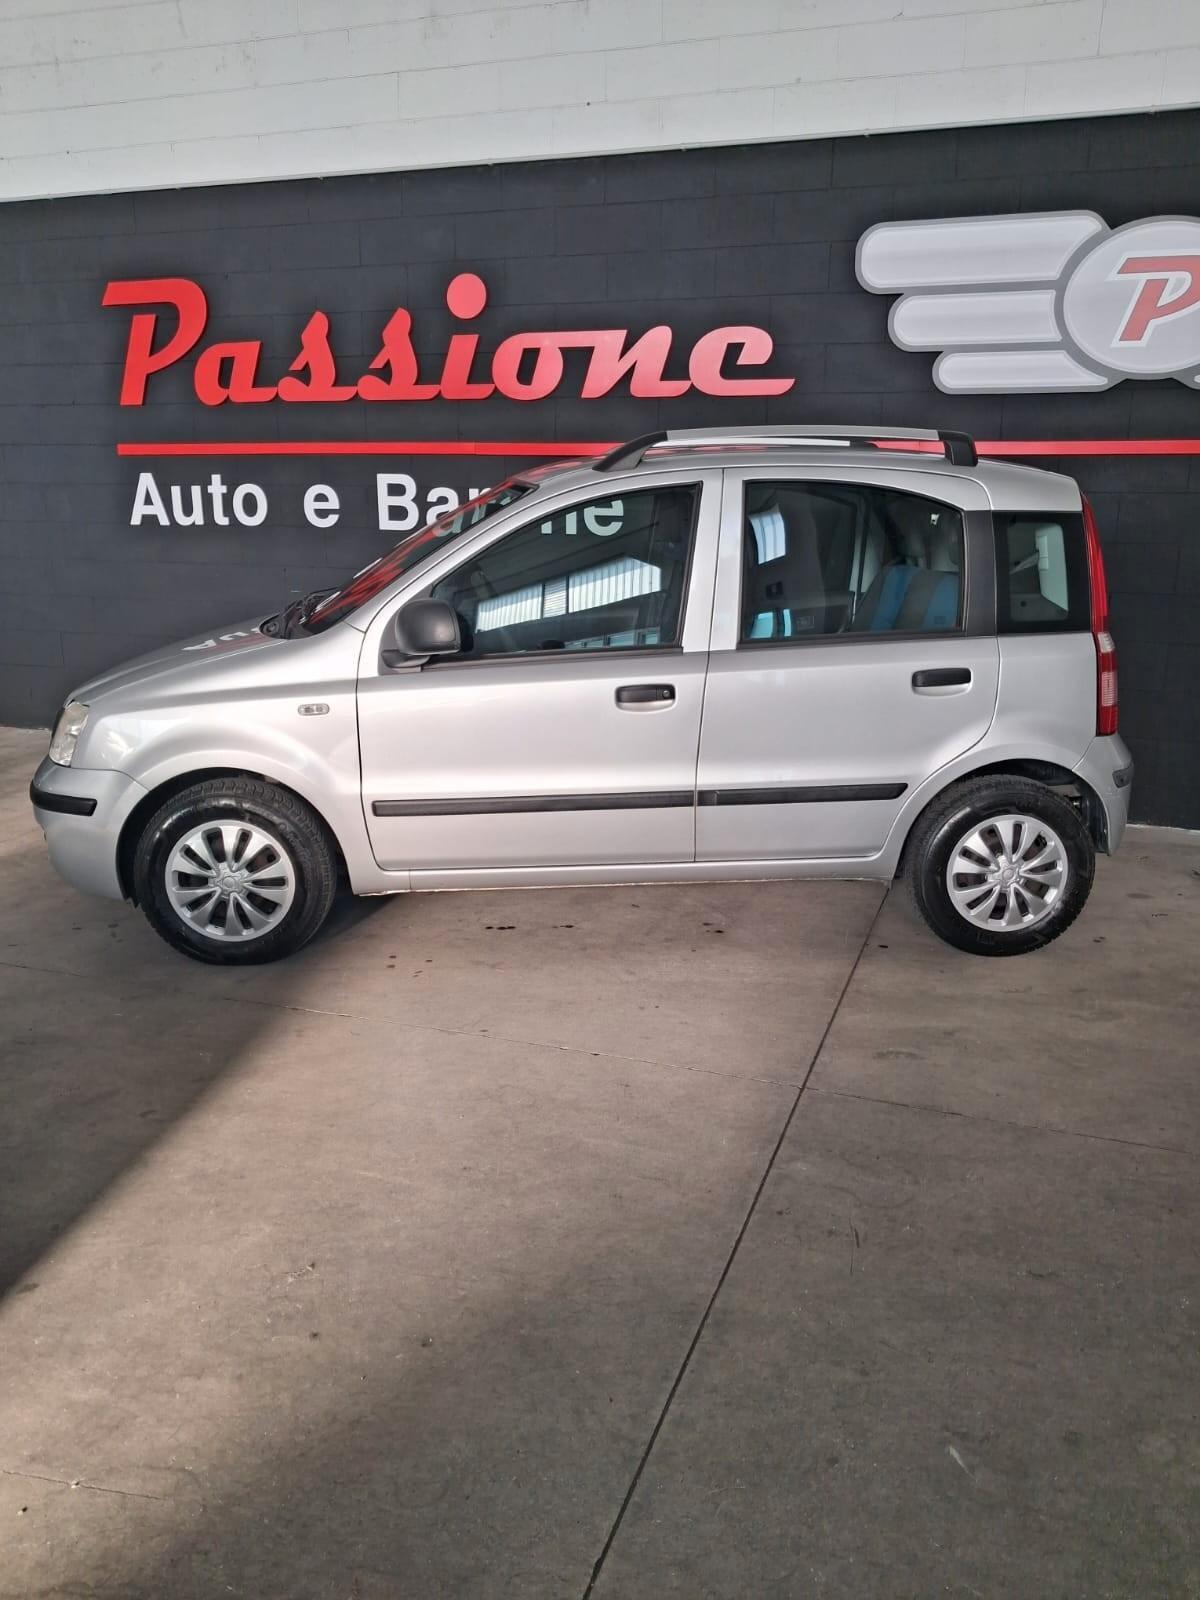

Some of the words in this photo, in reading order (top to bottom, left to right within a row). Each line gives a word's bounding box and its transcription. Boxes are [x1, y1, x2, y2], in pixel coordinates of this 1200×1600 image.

[102, 273, 796, 406] Passione
[129, 471, 269, 528] Auto
[303, 482, 341, 529] e
[375, 471, 625, 538] Bare
